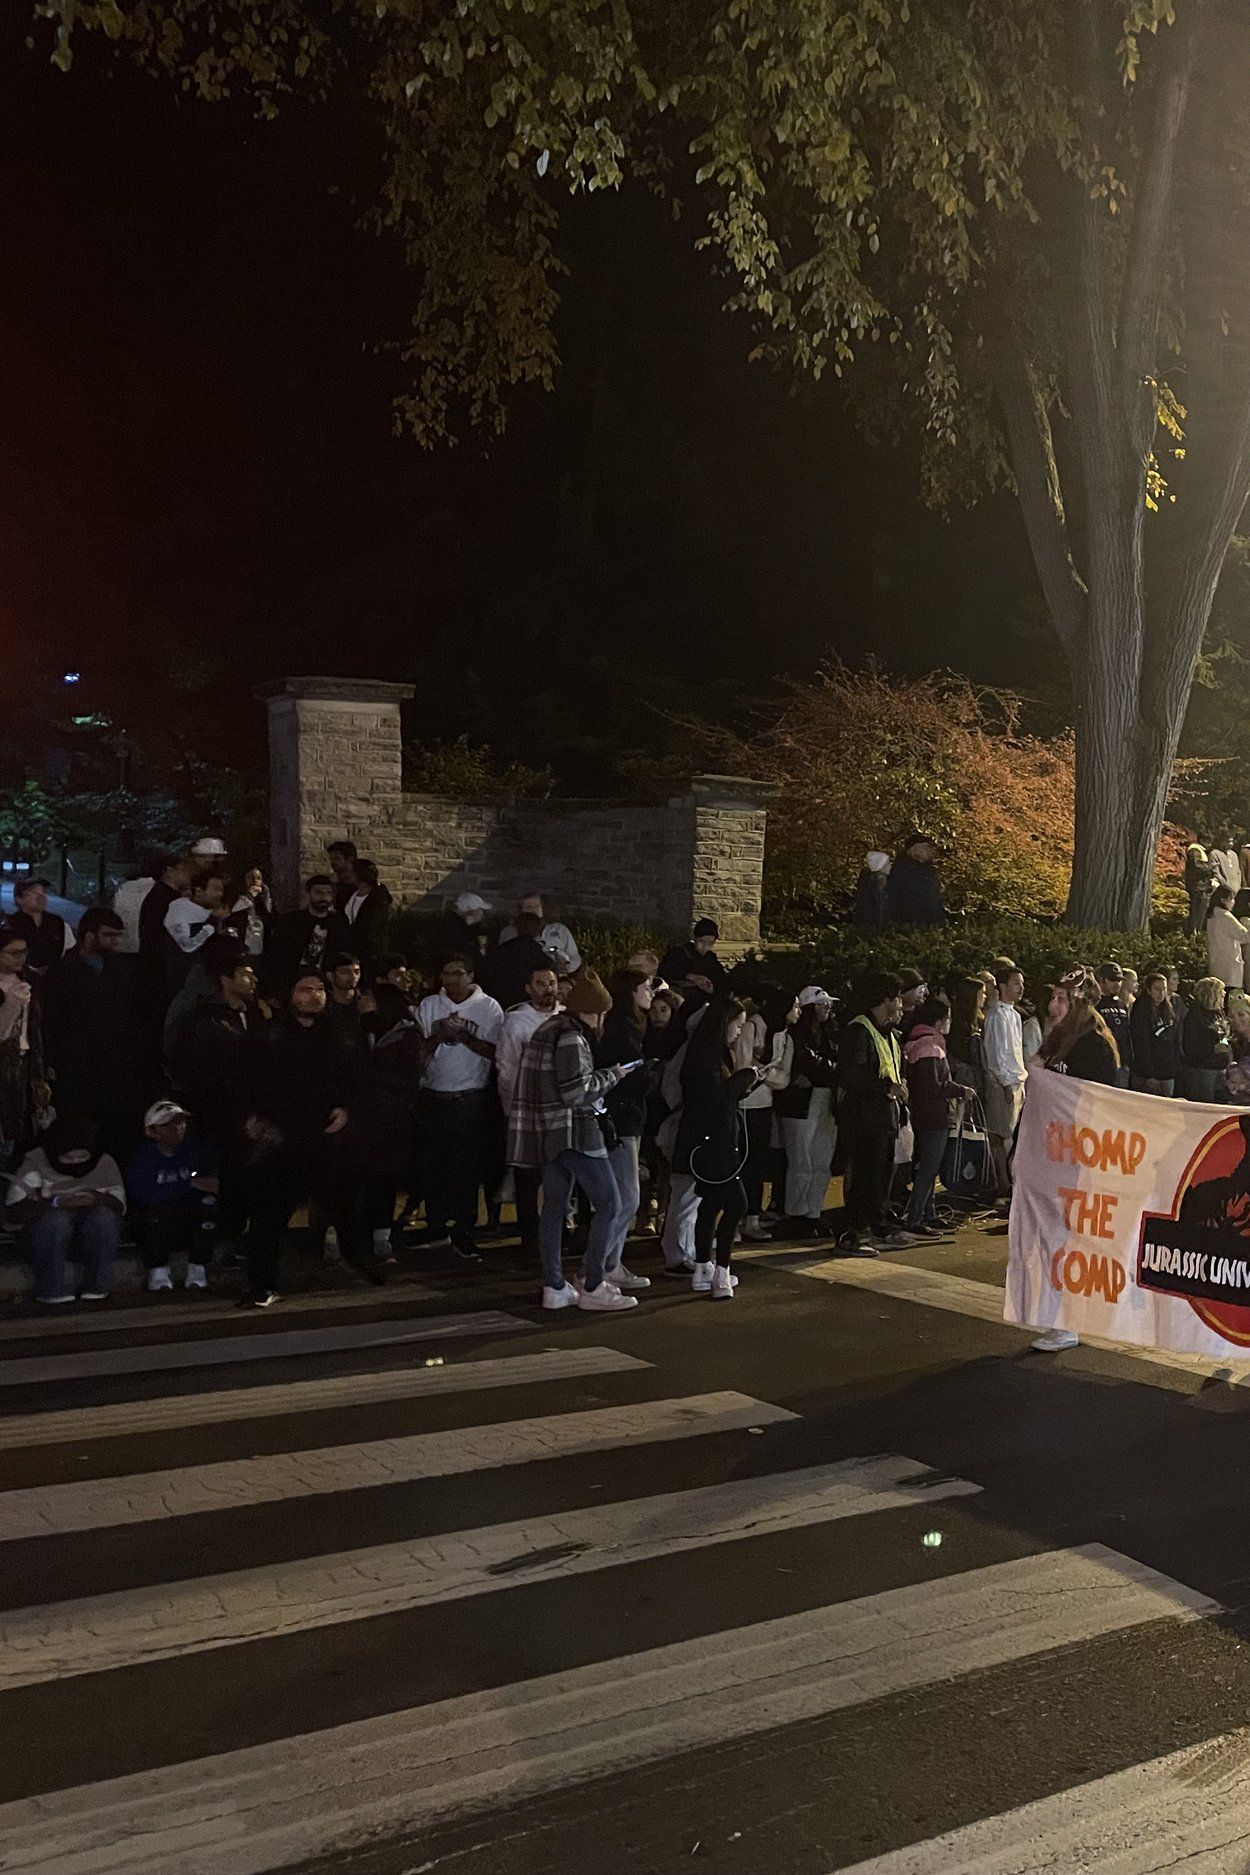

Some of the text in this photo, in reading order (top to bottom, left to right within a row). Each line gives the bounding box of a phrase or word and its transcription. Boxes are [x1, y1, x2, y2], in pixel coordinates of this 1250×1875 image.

[1058, 1187, 1118, 1239] THE
[1051, 1247, 1126, 1304] COMP
[1142, 1243, 1208, 1282] JURASSIC
